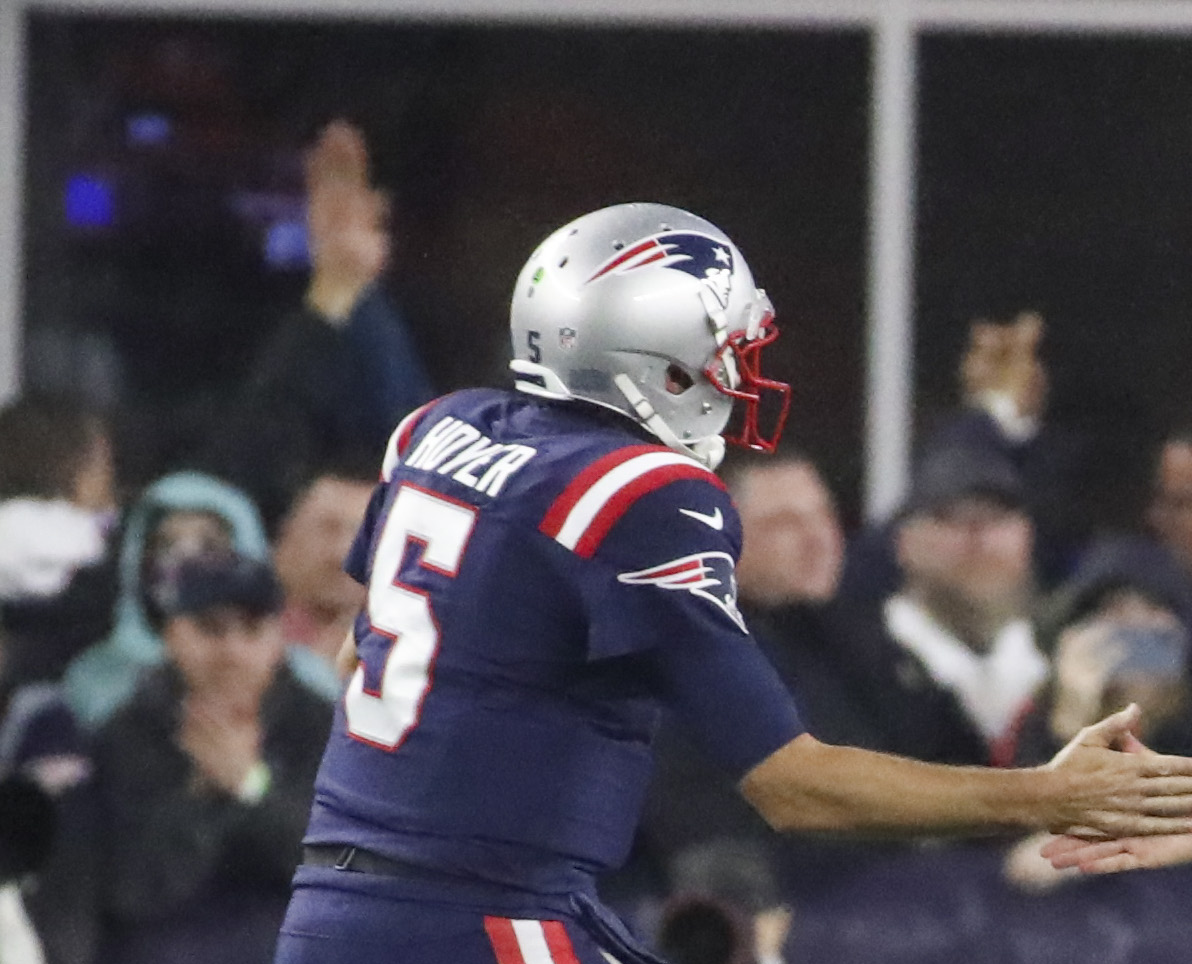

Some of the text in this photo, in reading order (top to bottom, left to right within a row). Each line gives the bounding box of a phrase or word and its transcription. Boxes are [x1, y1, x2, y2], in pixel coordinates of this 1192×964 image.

[527, 329, 541, 364] 5
[404, 415, 538, 498] HOYER
[344, 481, 480, 753] 5
